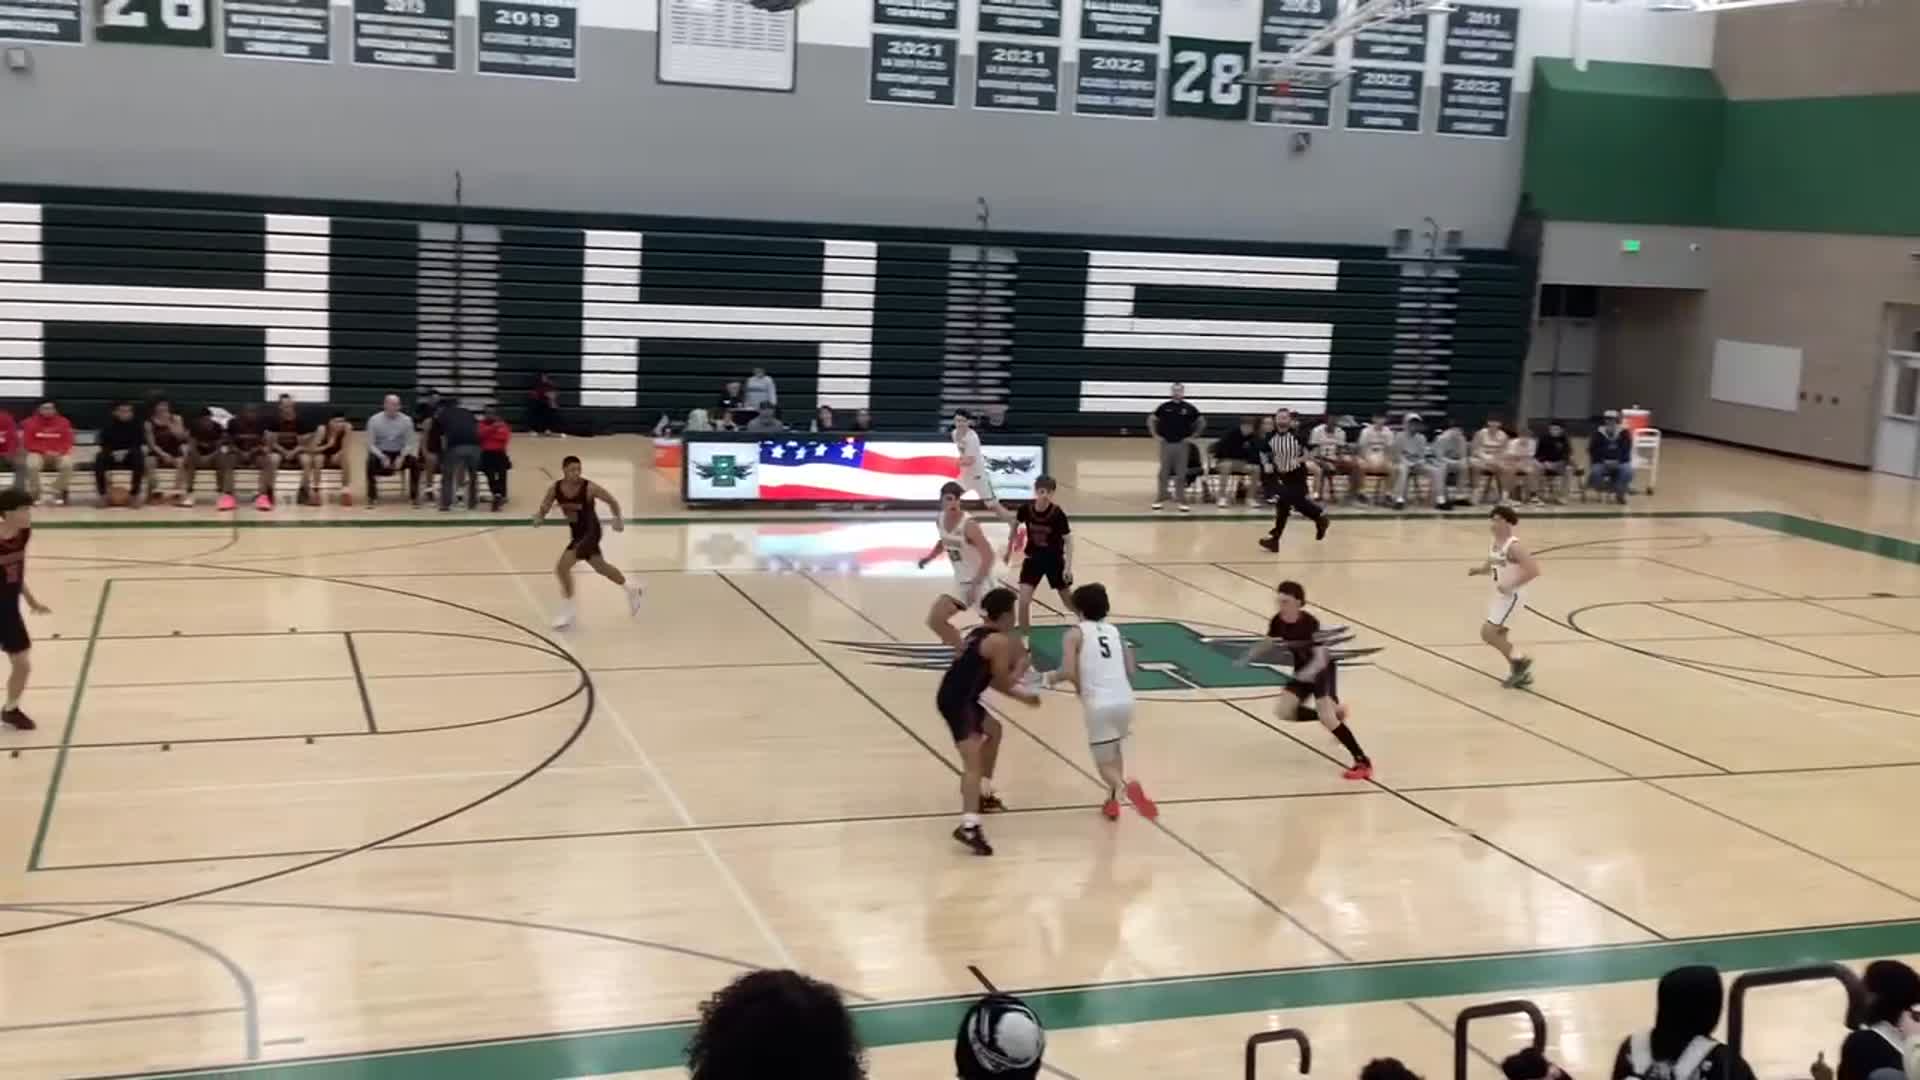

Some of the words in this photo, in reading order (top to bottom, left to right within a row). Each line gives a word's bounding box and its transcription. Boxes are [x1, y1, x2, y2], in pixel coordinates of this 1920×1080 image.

[495, 9, 560, 28] 2019
[887, 41, 944, 57] 2021
[991, 48, 1045, 64] 2021
[1091, 56, 1145, 73] 2022
[1172, 50, 1244, 105] 28
[1097, 635, 1112, 659] 5
